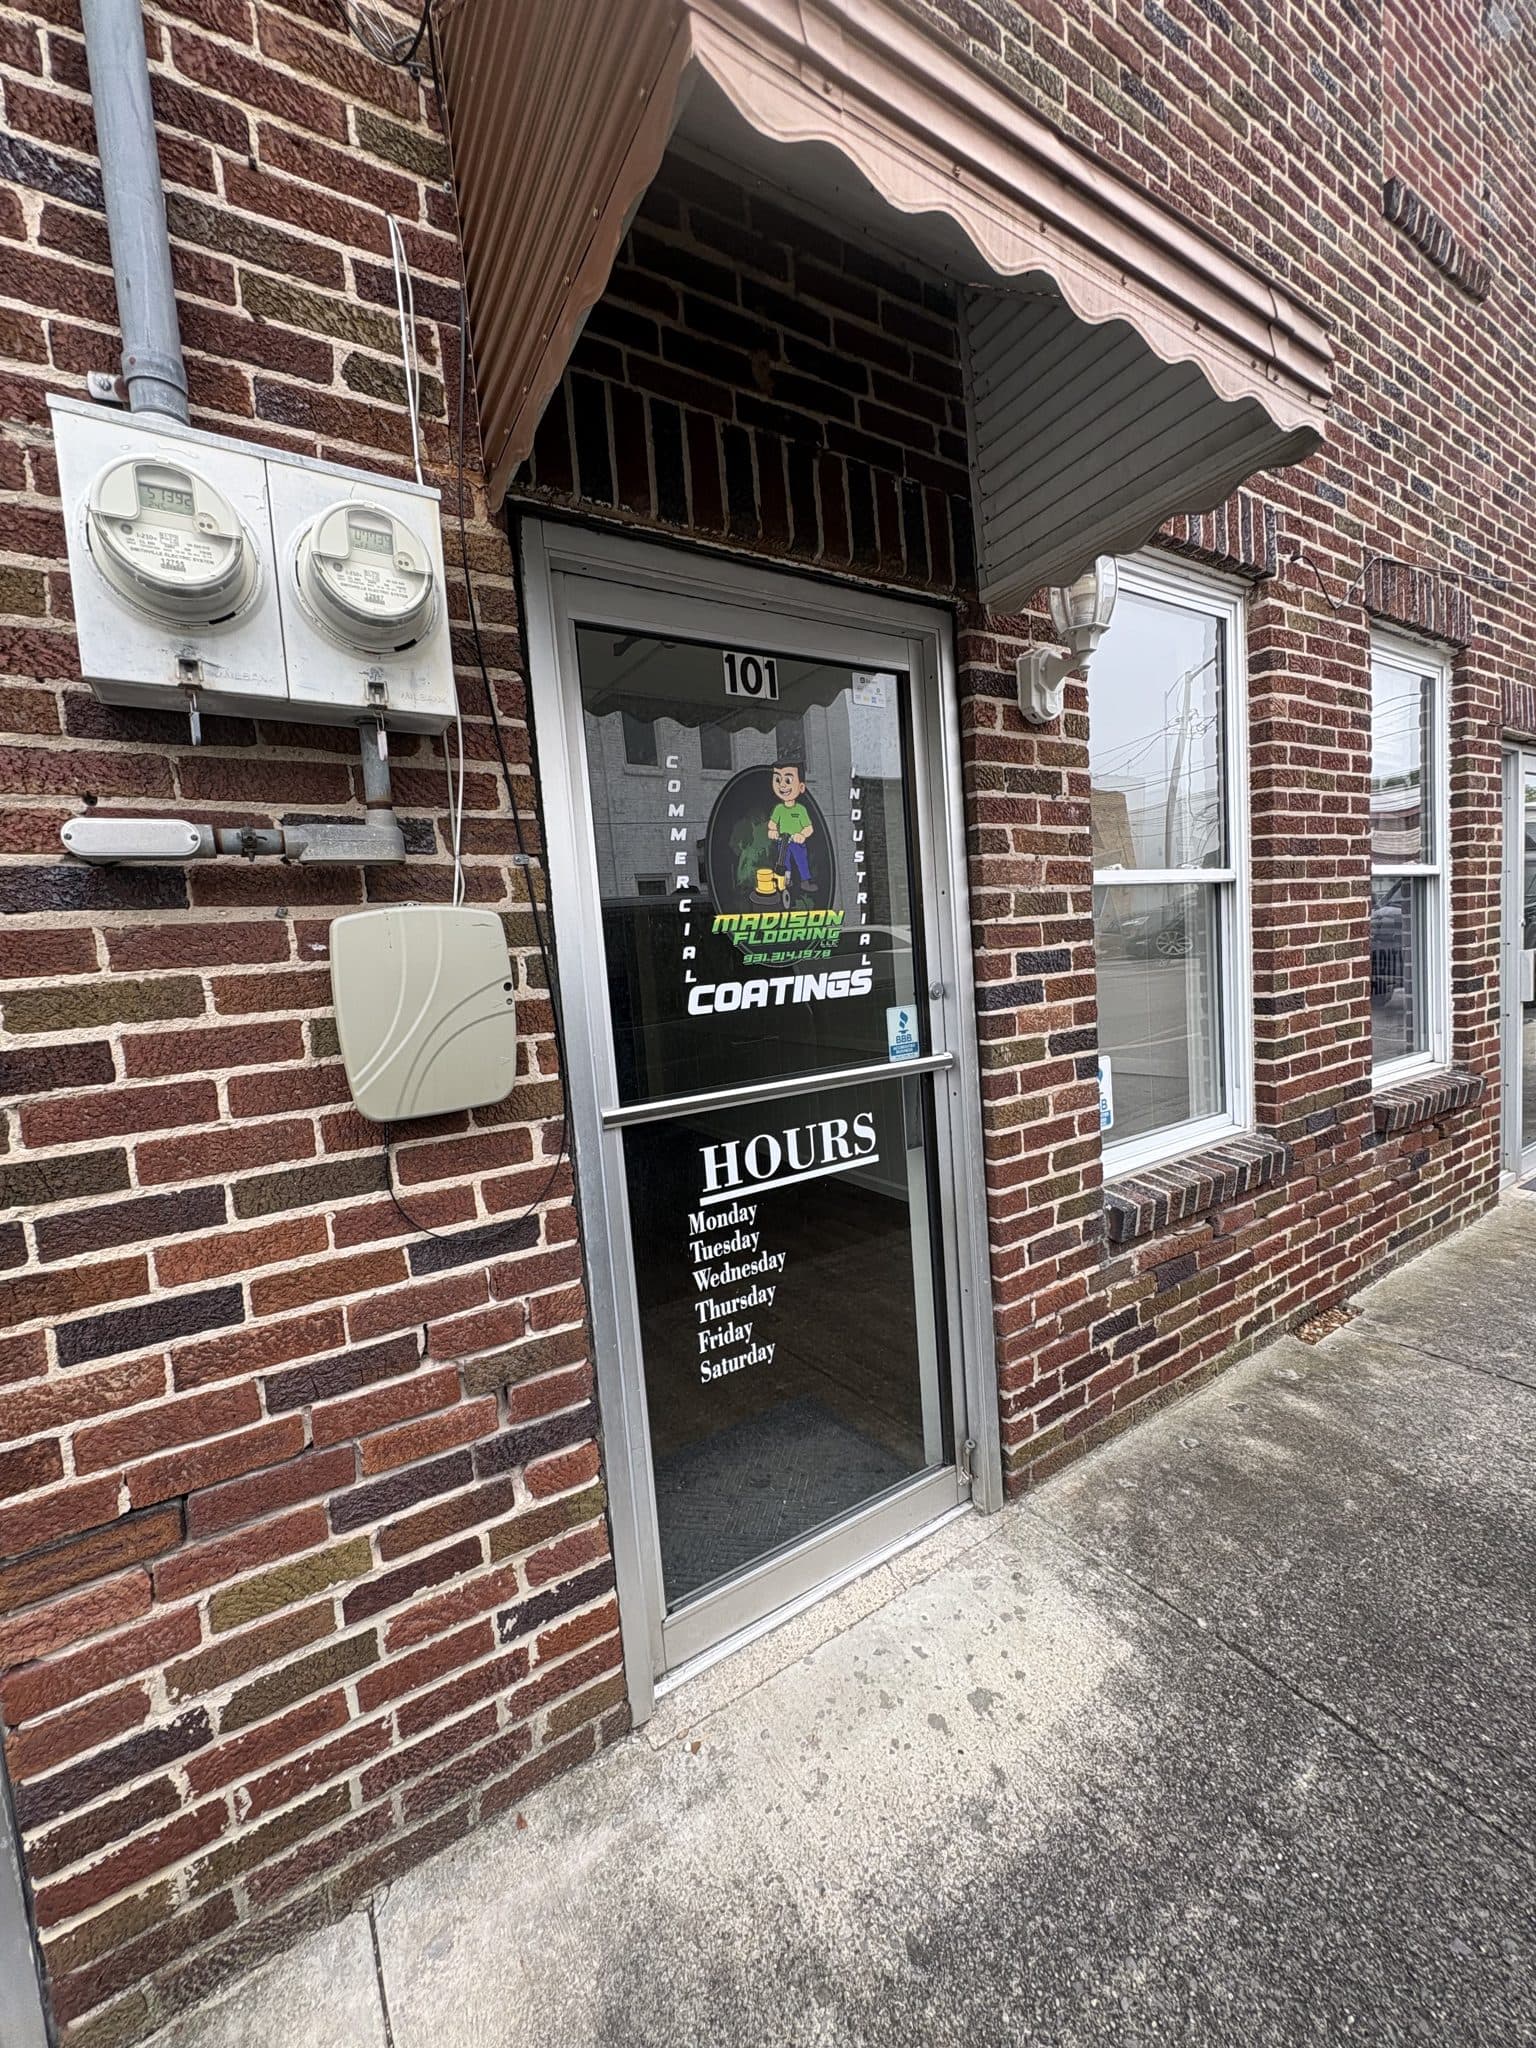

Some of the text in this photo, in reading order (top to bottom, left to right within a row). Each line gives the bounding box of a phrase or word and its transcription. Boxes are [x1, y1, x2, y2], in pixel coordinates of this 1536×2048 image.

[725, 654, 777, 698] 101
[666, 755, 697, 983] COMMERCIAL
[849, 766, 870, 966] INDUSTRIAL
[712, 910, 845, 934] MADISON
[733, 927, 842, 946] FLOORING
[743, 950, 832, 966] 931.314.1978
[688, 968, 873, 1015] COATINGS
[896, 1034, 912, 1043] BBB
[699, 1112, 876, 1192] HOURS
[688, 1202, 757, 1236] Monday
[689, 1229, 760, 1263] Tuesday
[692, 1250, 787, 1292] Wednesday
[695, 1284, 776, 1324] Thursday
[697, 1321, 753, 1354] Friday
[700, 1343, 776, 1384] Saturday
